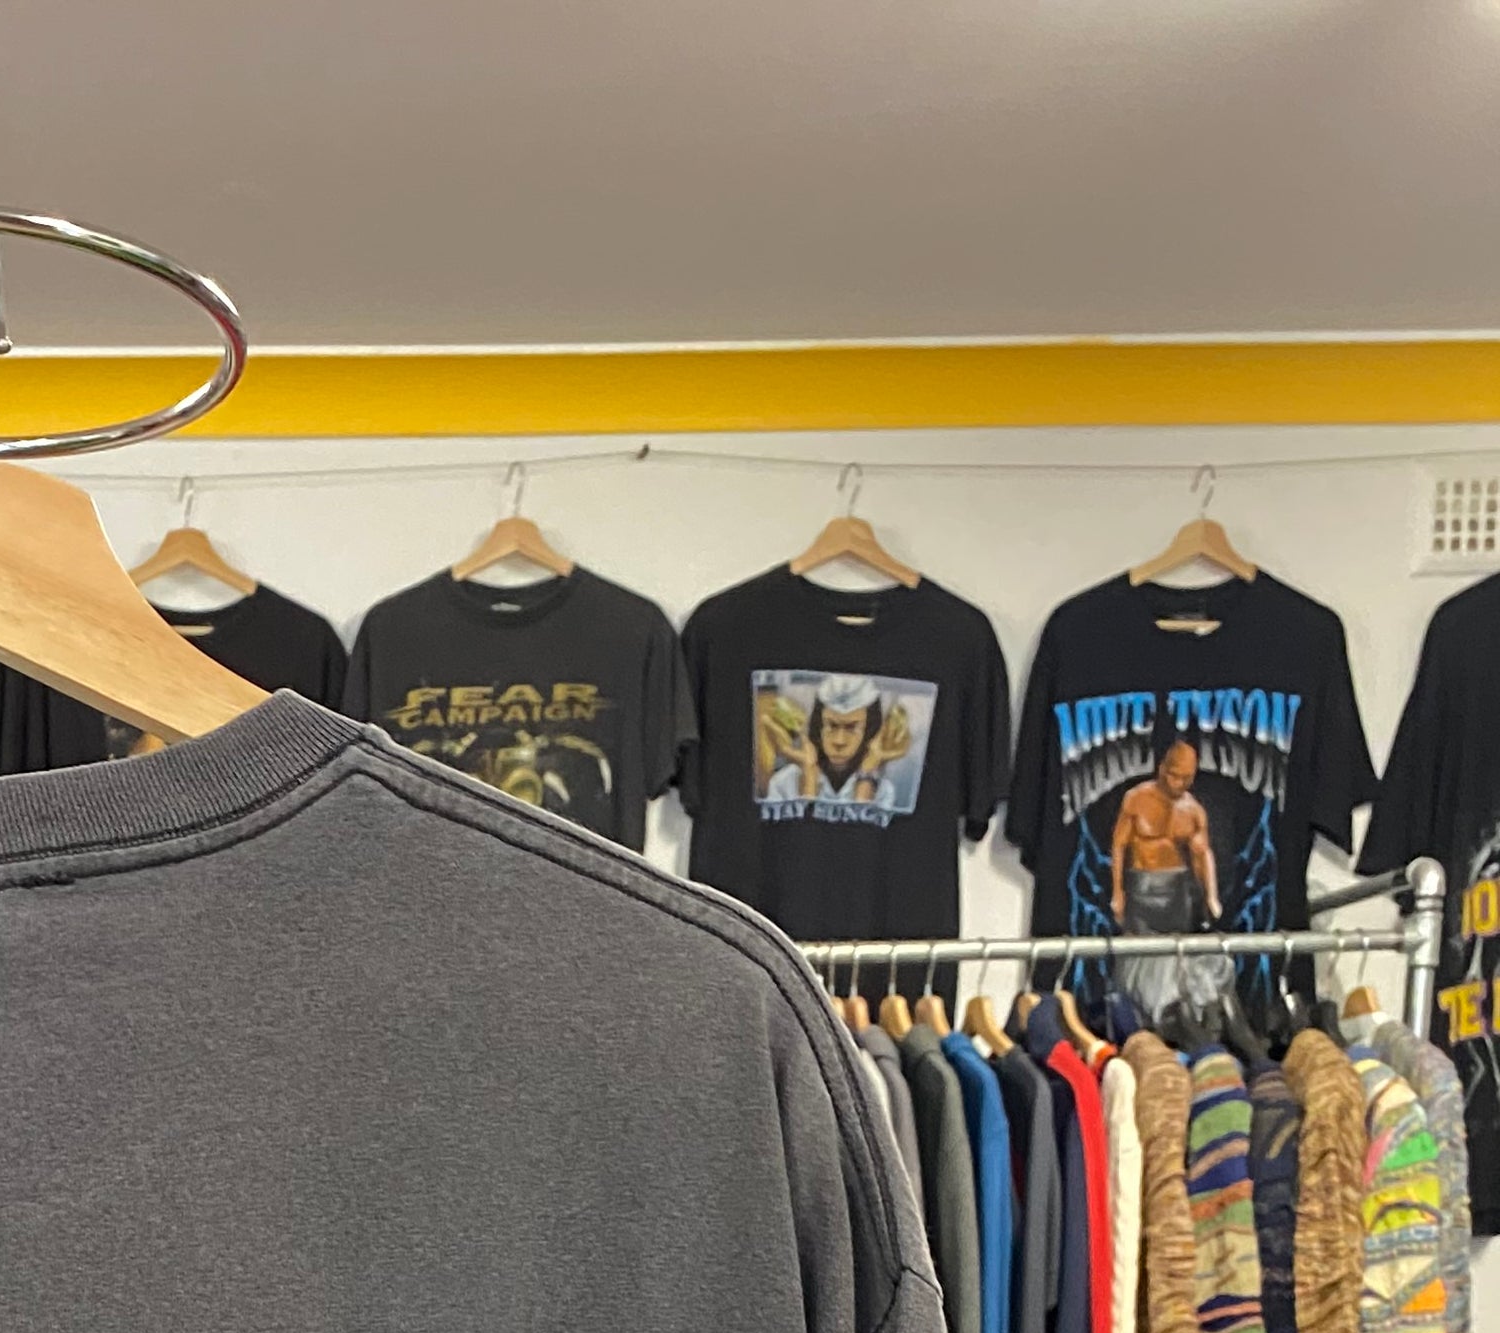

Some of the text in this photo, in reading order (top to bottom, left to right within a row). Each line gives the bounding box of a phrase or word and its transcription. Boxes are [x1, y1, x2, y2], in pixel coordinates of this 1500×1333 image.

[405, 682, 599, 708] FEAR
[398, 702, 598, 730] CAMPAIGN
[1054, 687, 1301, 764] MIKE TYSON
